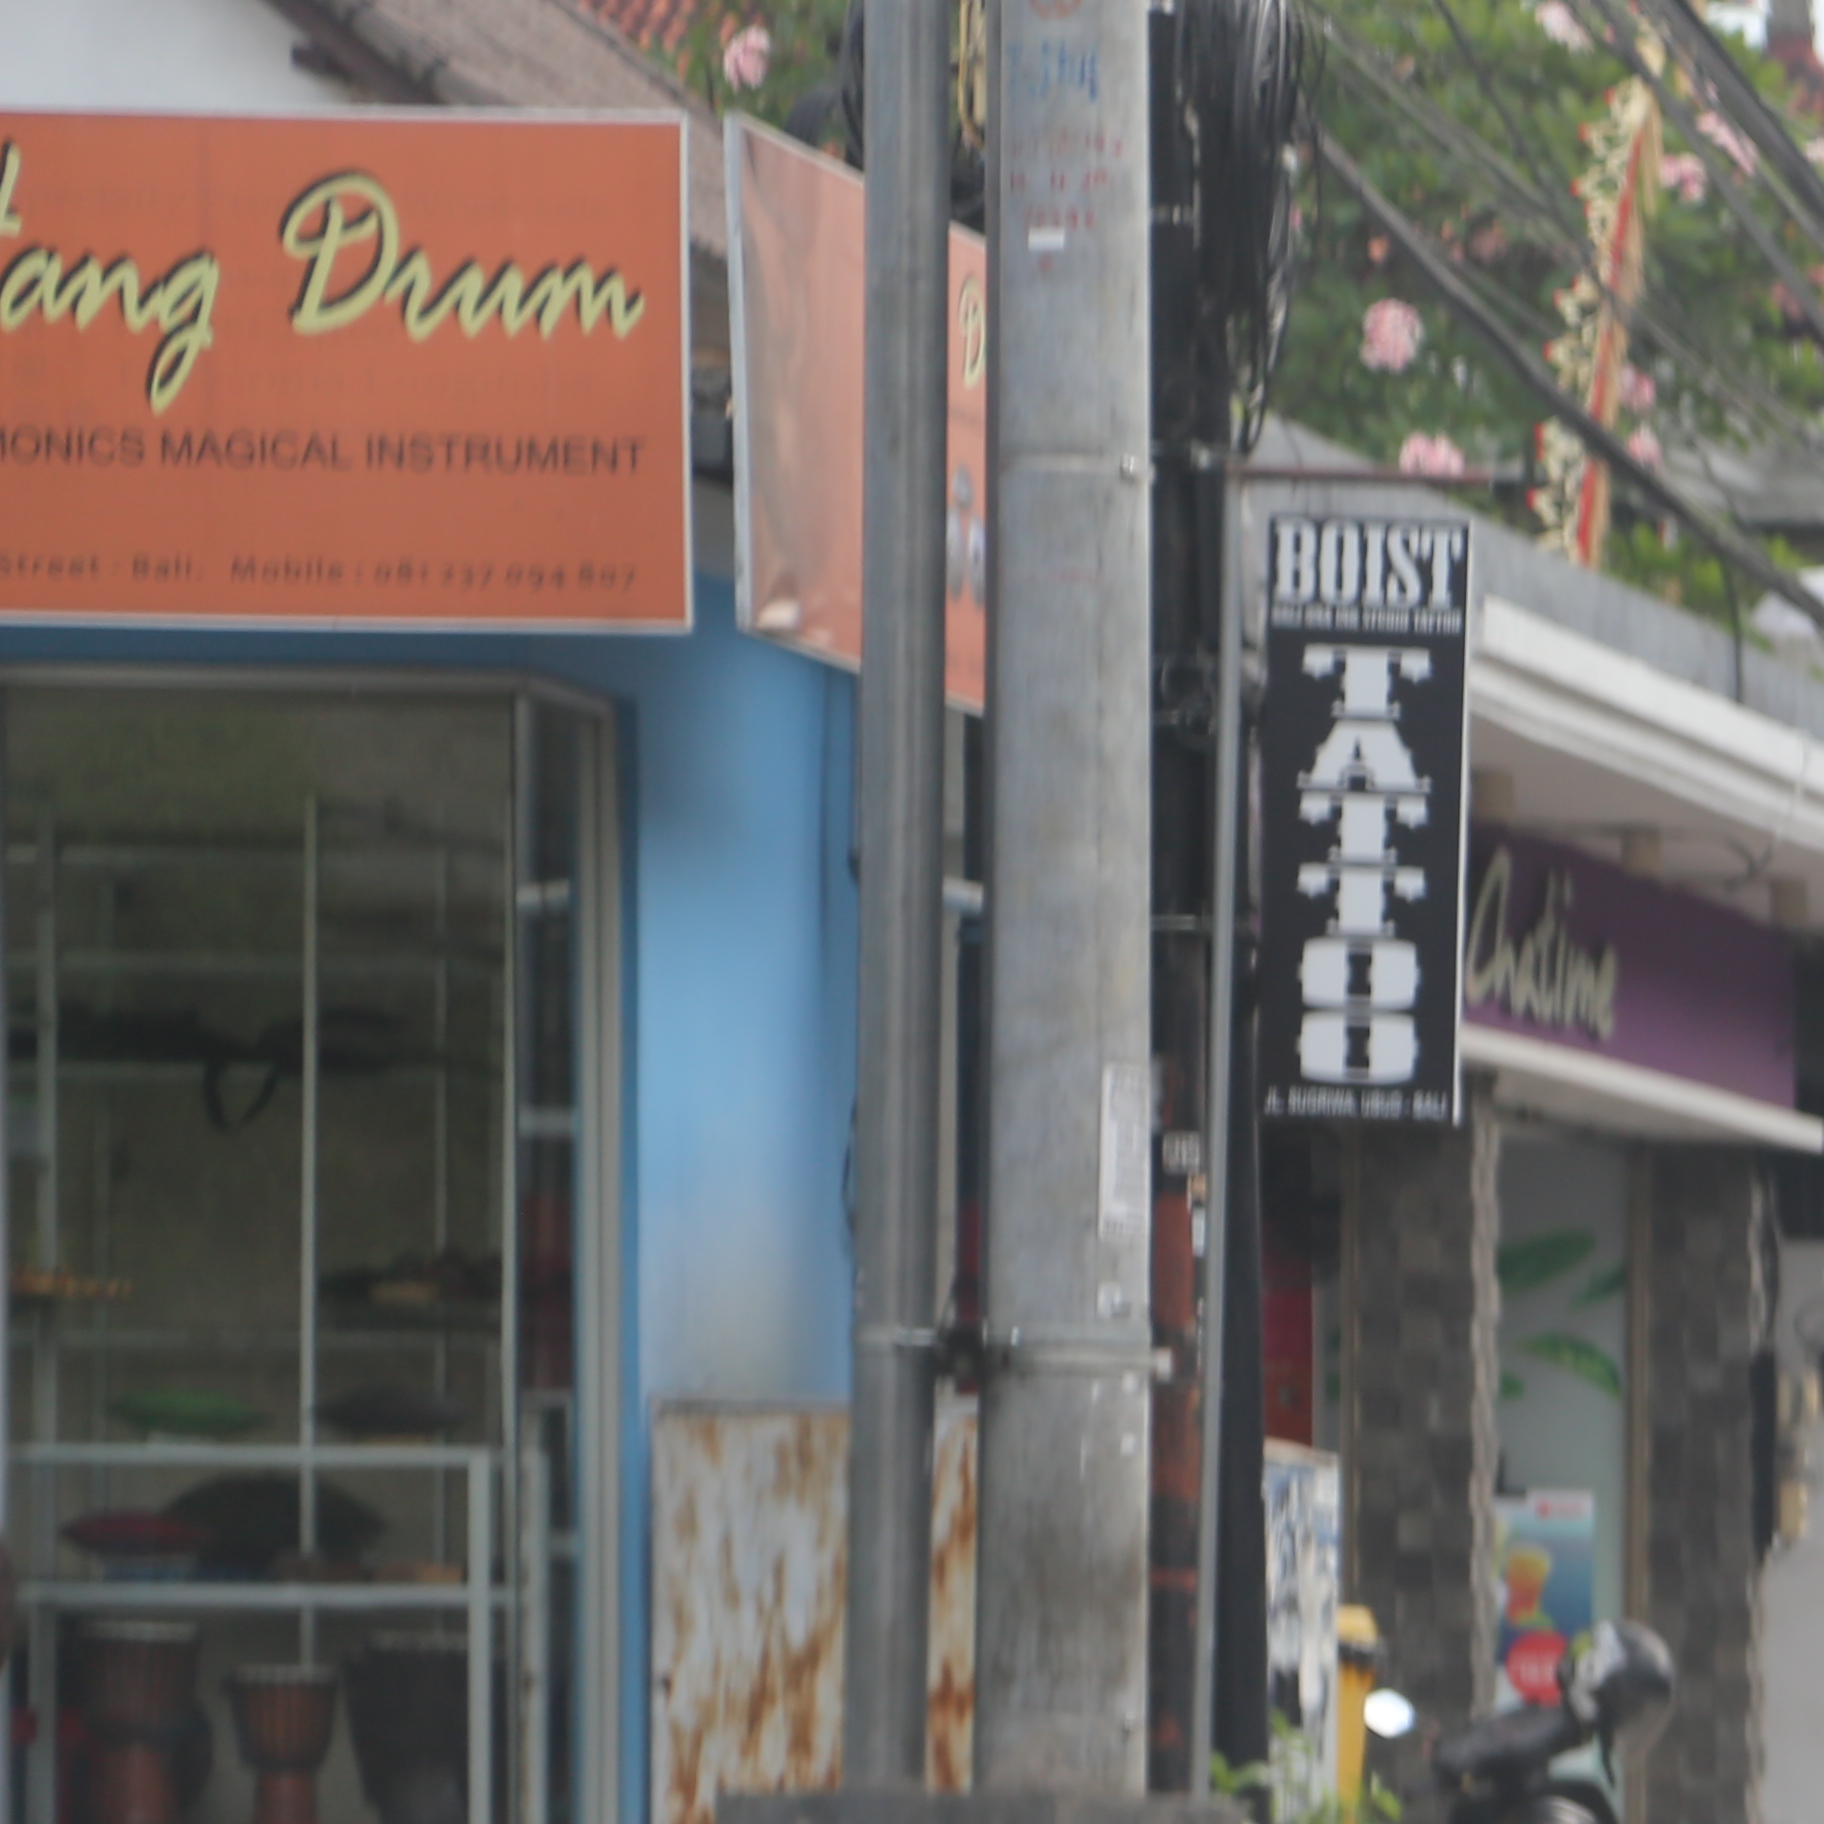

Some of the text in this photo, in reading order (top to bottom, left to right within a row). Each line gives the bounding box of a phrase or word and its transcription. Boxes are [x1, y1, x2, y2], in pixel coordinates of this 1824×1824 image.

[280, 168, 646, 341] Drum
[0, 424, 648, 477] ONICS MAGICAL INSTRUMENT
[1272, 520, 1463, 608] BOIST
[1296, 643, 1432, 1086] TATTOO
